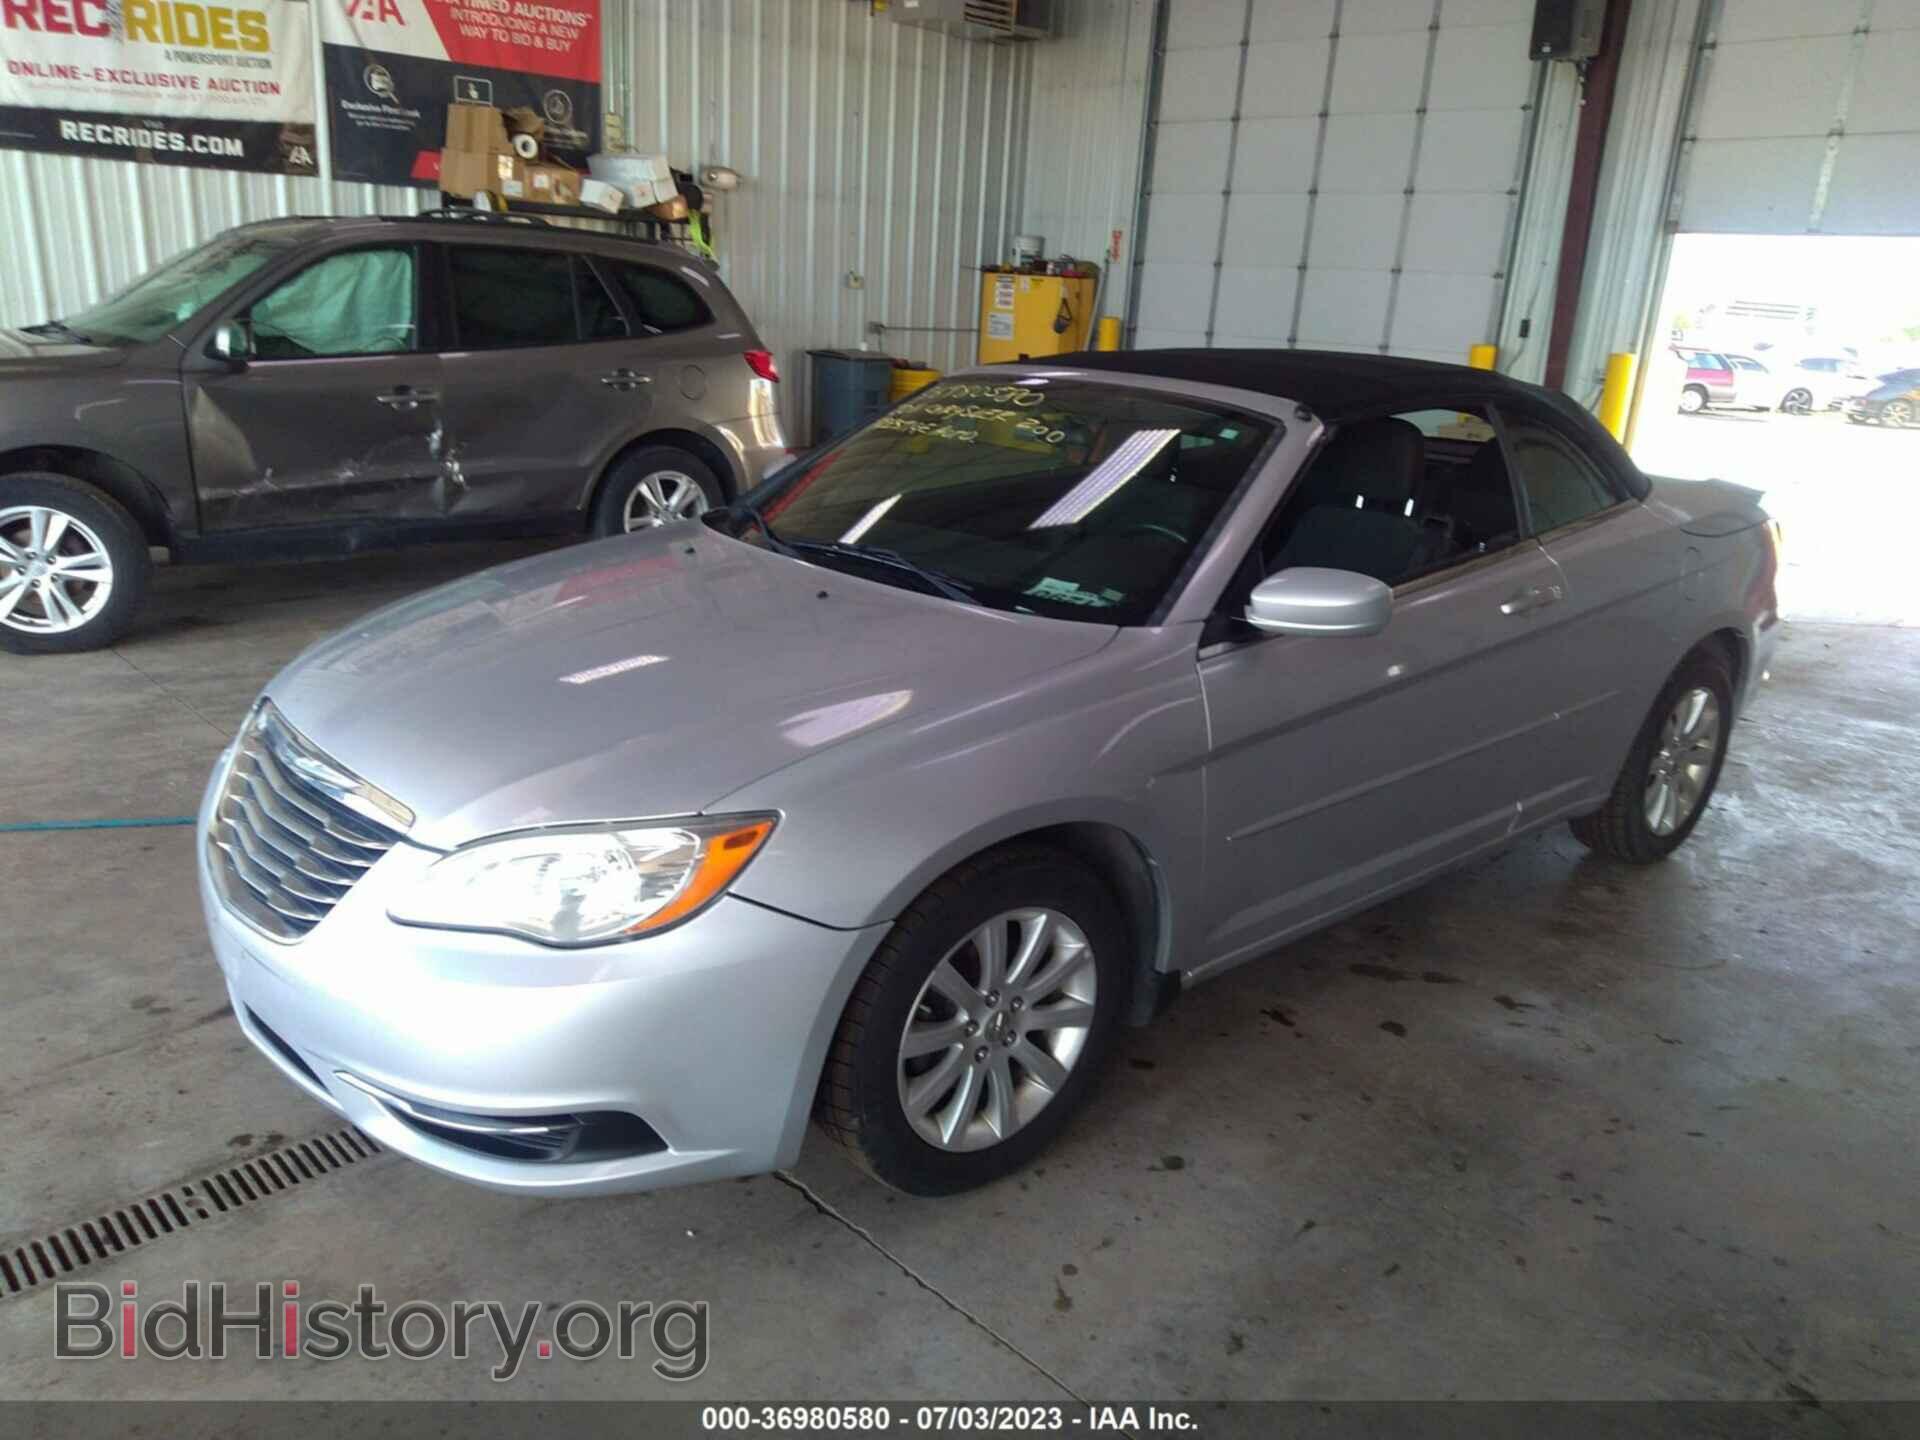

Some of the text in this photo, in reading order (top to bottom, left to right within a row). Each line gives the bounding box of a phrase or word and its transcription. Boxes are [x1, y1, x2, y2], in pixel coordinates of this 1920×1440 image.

[3, 0, 269, 53] REC RIDES
[460, 24, 489, 39] WAY
[492, 28, 509, 42] TO
[512, 31, 531, 46] BID
[546, 37, 571, 52] BUY
[7, 59, 200, 90] ONLINE-EXCLUSIVE
[207, 77, 281, 96] AUCTION
[59, 119, 244, 157] RECRIDES.COM
